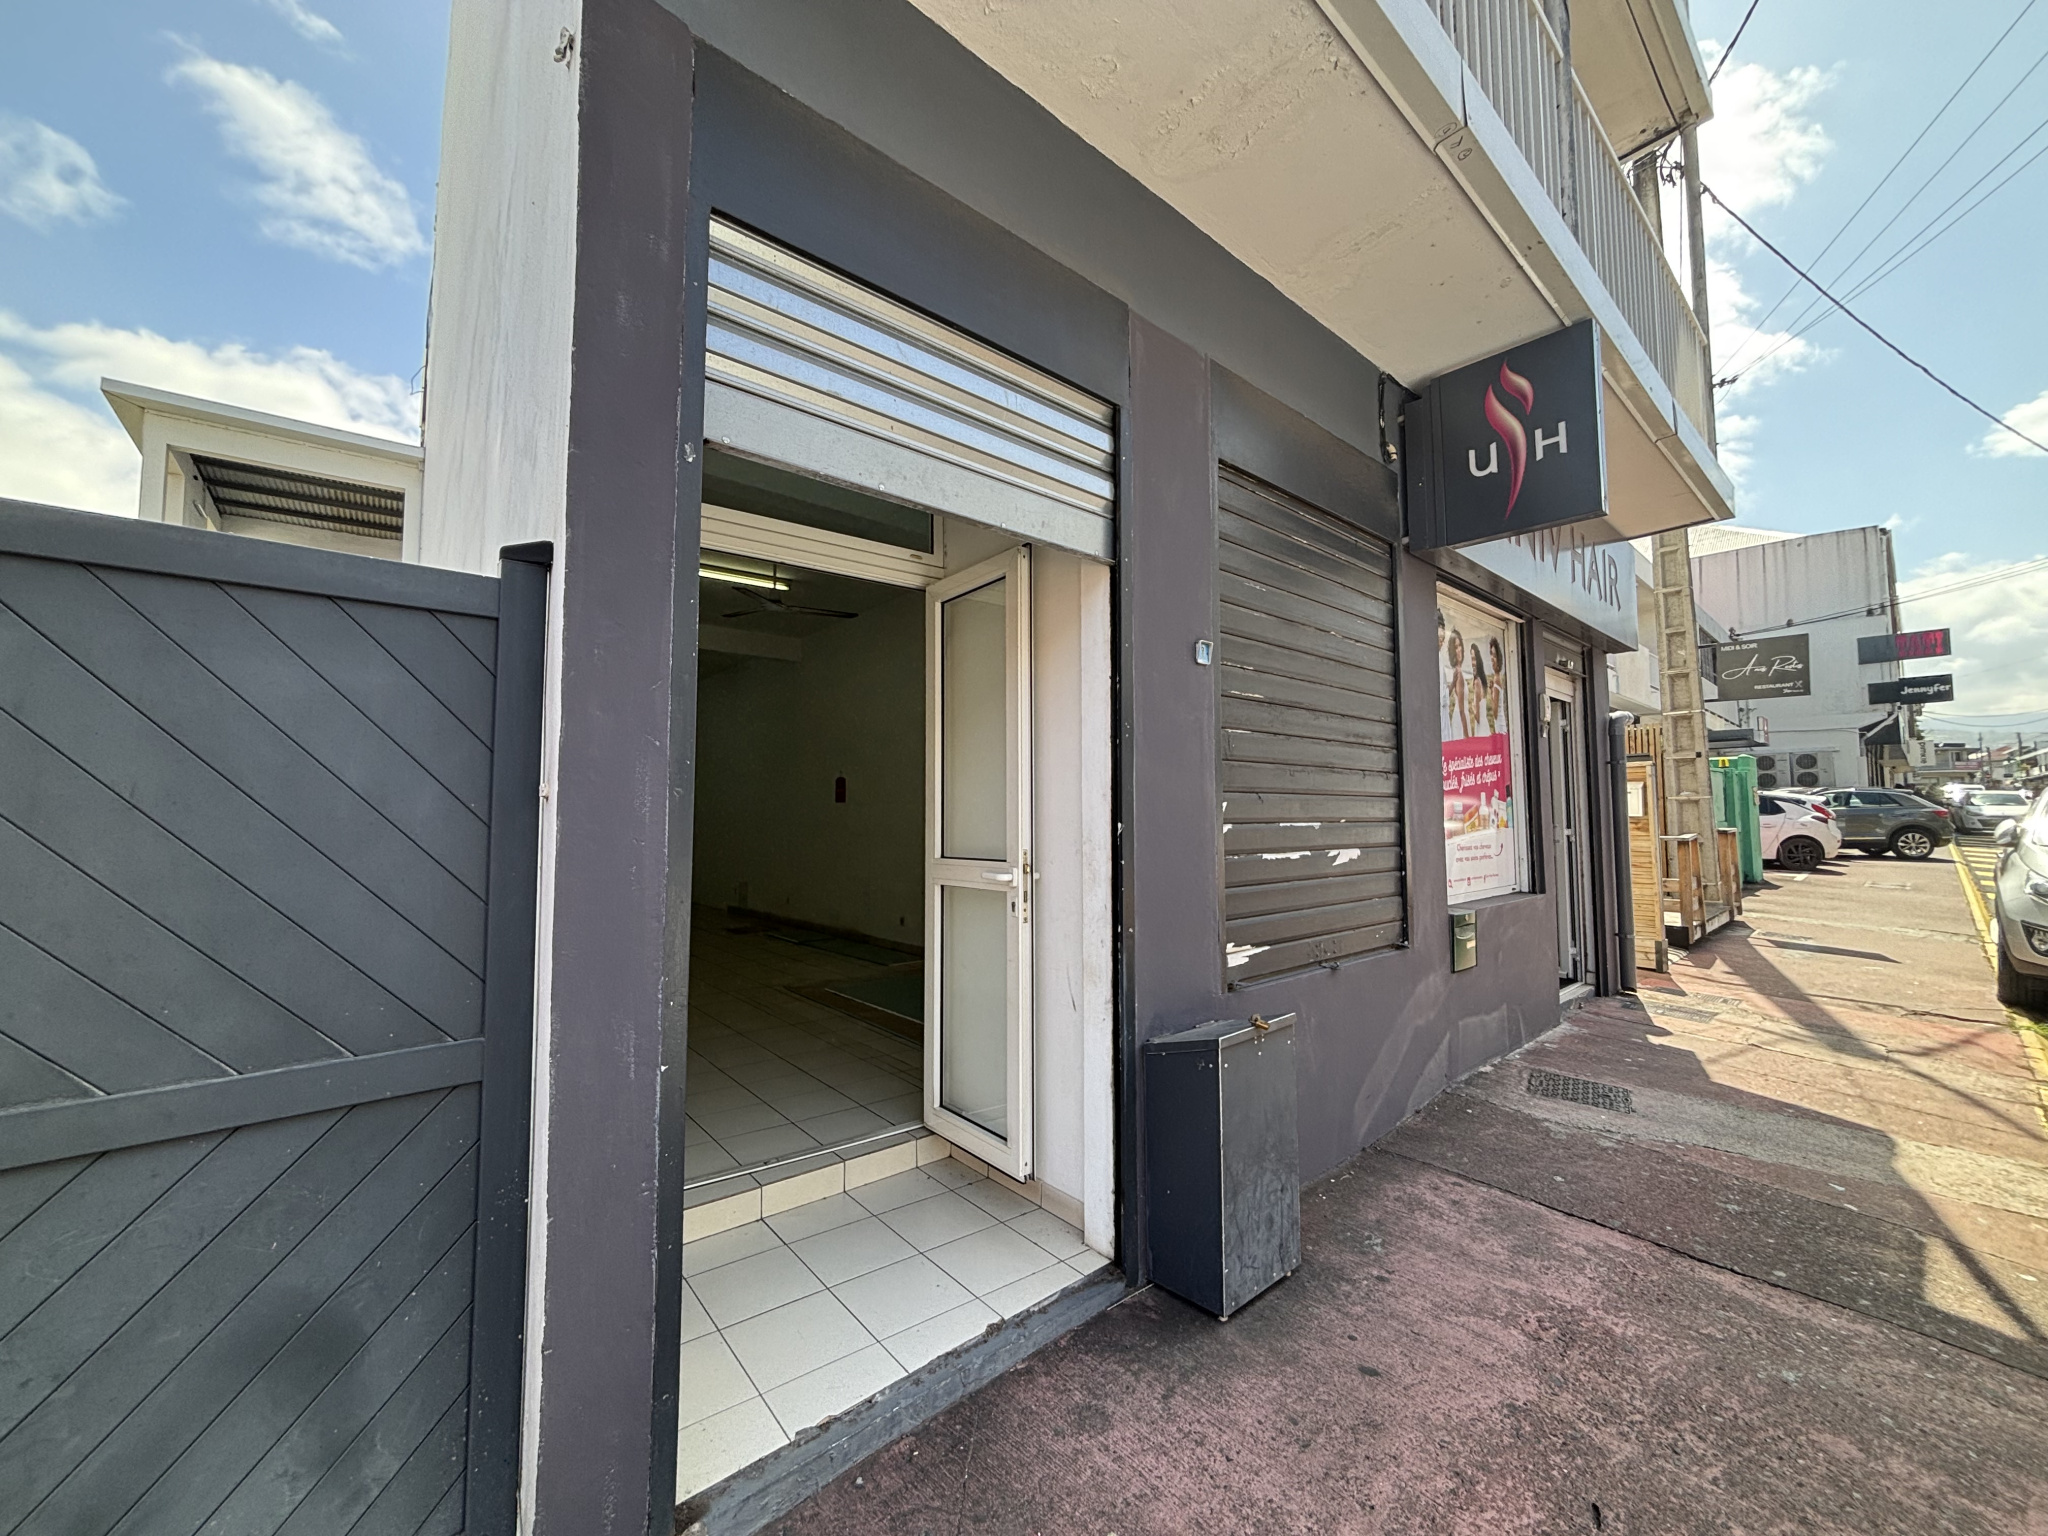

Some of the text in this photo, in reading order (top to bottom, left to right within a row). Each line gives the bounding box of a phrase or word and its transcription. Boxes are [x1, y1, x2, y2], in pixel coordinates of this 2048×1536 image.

[1570, 525, 1621, 612] HAIR
[1895, 630, 1944, 658] TATI
[1754, 682, 1794, 690] RESTAURANT
[1900, 683, 1951, 695] Jennyfer
[1475, 754, 1483, 767] des
[1484, 752, 1502, 766] cheveux
[1459, 771, 1476, 794] frisés
[1476, 770, 1482, 785] et
